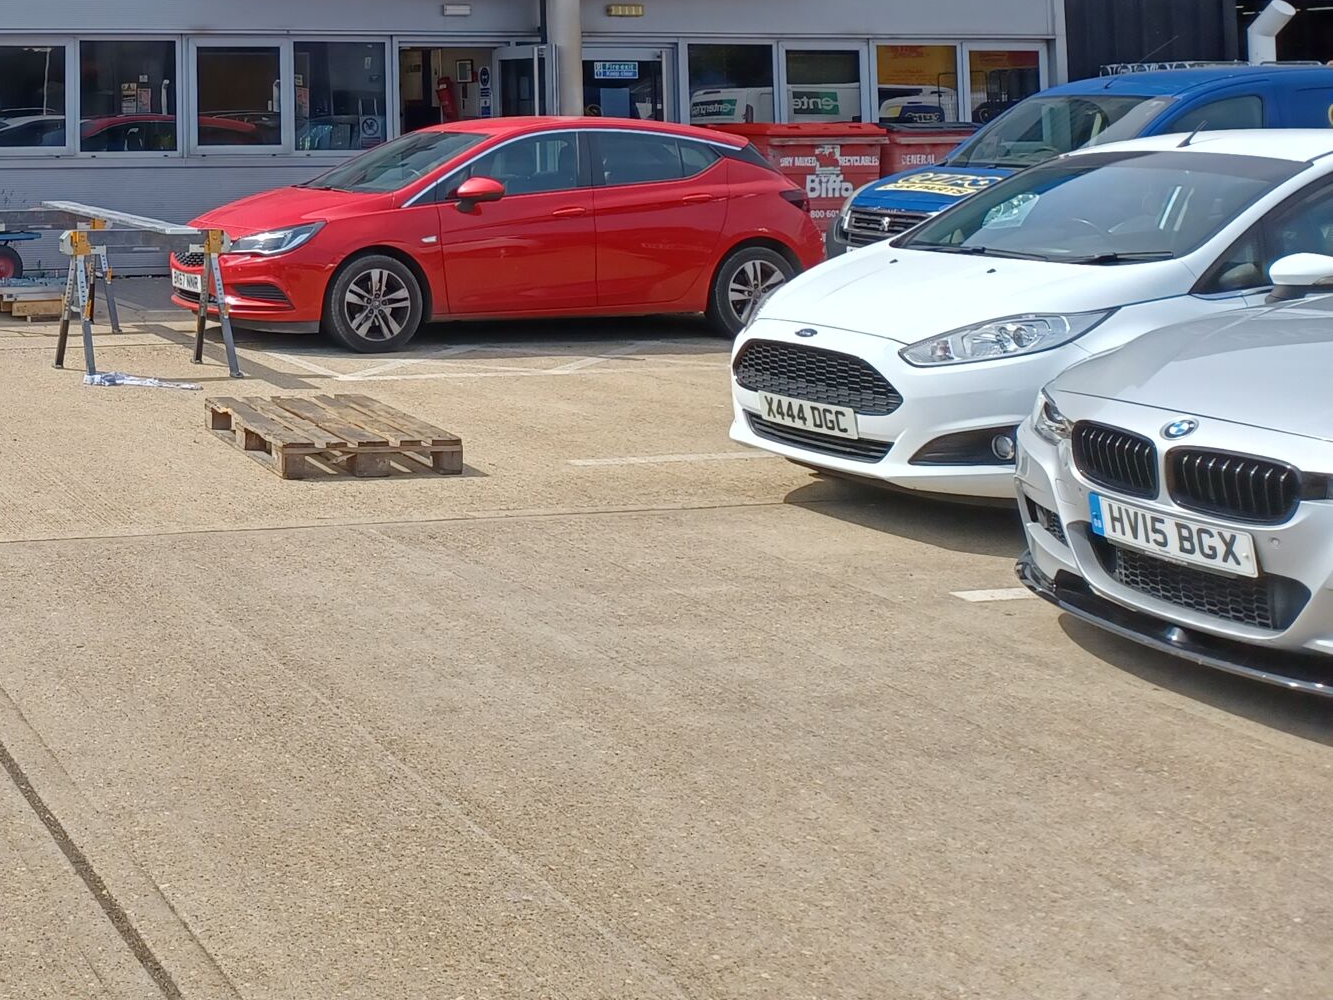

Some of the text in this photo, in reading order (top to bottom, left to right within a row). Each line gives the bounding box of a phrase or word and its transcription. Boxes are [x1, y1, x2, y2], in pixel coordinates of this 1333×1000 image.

[764, 395, 849, 433] X444 DGC
[1108, 503, 1242, 567] HV15 BGX
